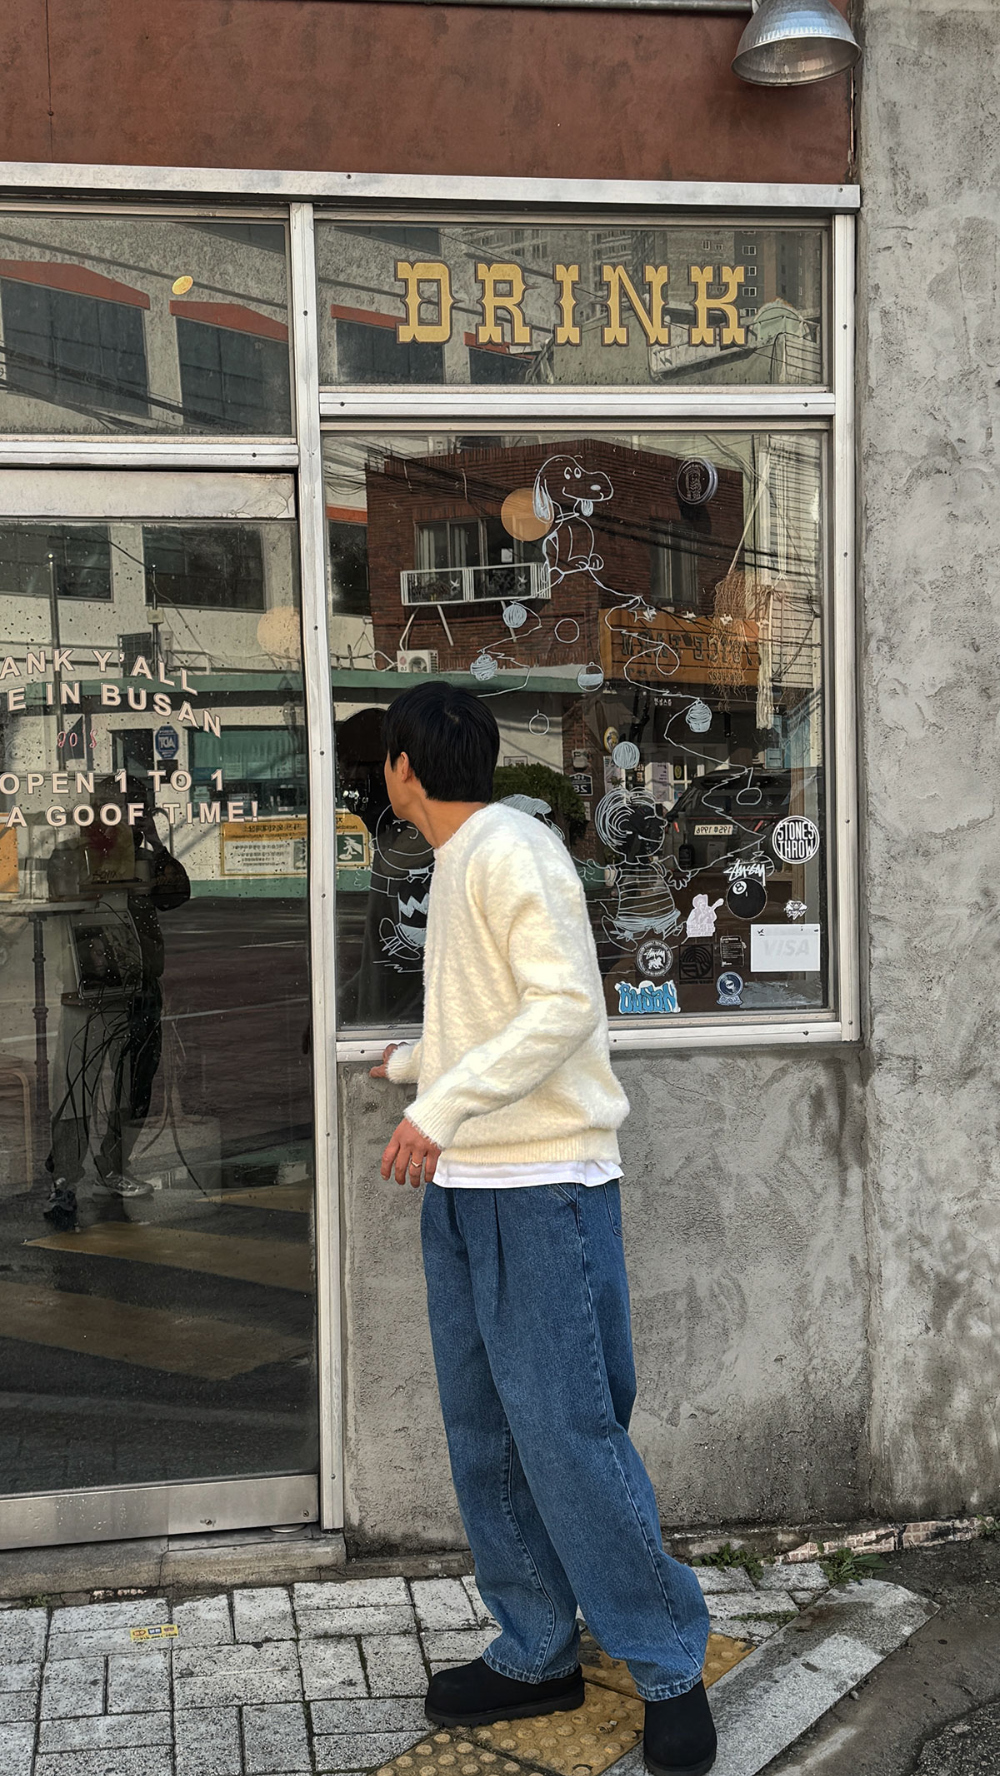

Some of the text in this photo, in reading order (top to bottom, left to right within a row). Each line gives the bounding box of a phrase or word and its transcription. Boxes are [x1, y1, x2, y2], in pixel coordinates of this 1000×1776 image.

[395, 260, 748, 347] DRINK
[92, 649, 198, 696] Y'ALL
[46, 682, 80, 705] IN
[101, 682, 222, 738] BUSAN
[0, 768, 223, 795] OPEN 1 TO 1
[7, 801, 258, 828] A GOOF TIME!
[777, 821, 814, 841] STONES
[778, 840, 814, 859] THROW
[762, 938, 810, 957] VISA
